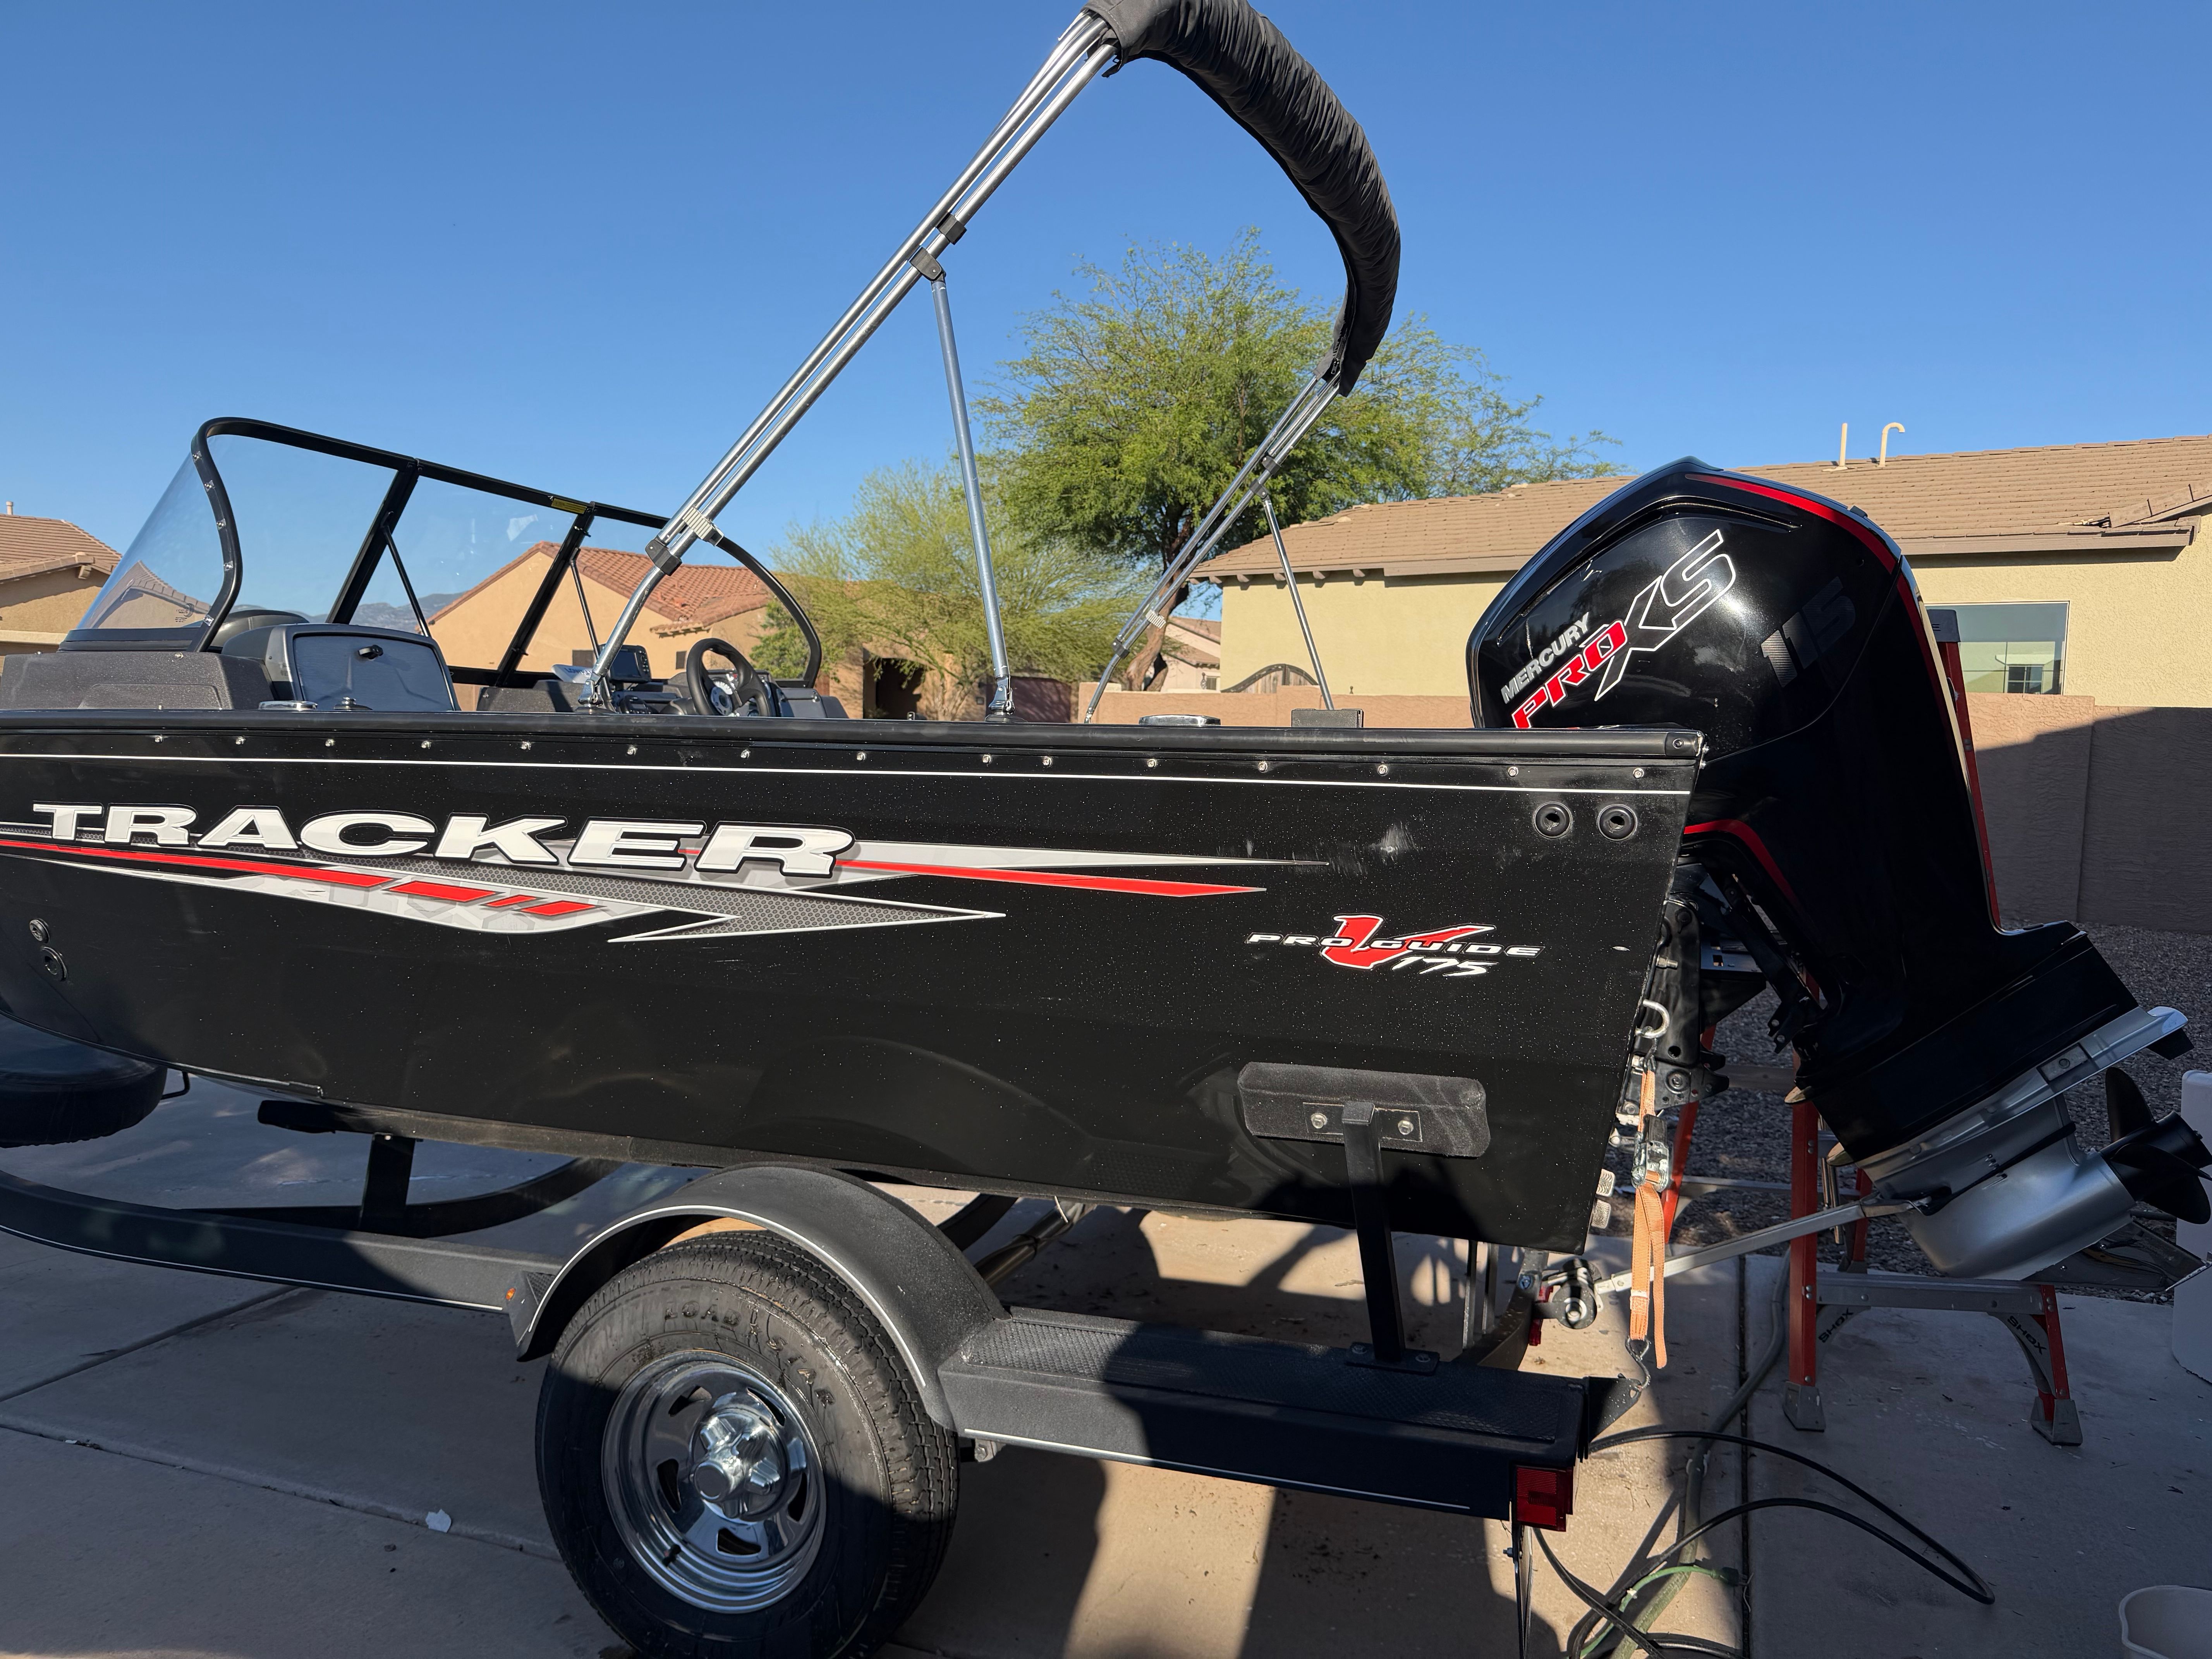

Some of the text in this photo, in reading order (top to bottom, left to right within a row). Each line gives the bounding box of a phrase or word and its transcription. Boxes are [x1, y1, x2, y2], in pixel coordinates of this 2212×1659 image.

[1511, 529, 1736, 728] PRO XS
[1761, 576, 1856, 688] 115
[1501, 611, 1591, 703] MERCURY
[32, 802, 855, 878] TRACKER
[1247, 933, 1545, 957] PRO GUIDE
[1392, 956, 1499, 977] 175
[664, 1300, 741, 1326] LOAD
[1819, 1308, 1853, 1343] SHOX
[2007, 1316, 2047, 1355] SHOX
